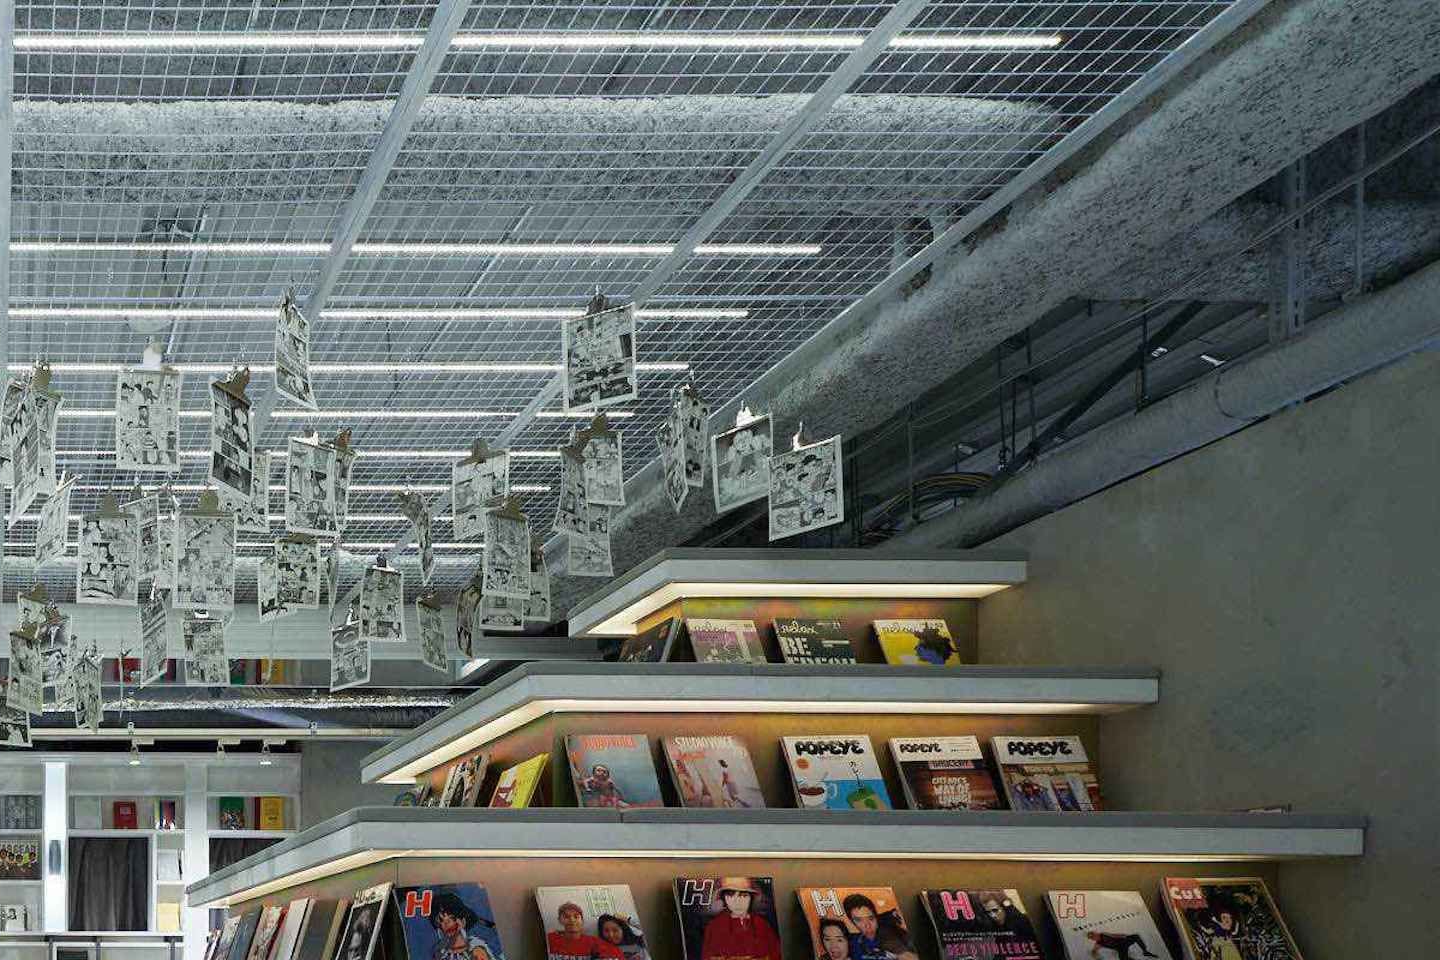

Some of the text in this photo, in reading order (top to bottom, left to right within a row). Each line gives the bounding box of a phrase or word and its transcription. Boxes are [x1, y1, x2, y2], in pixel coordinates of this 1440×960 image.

[795, 741, 864, 755] POPEYE
[899, 743, 942, 753] POPEYE
[1008, 741, 1072, 755] POPEYE
[405, 890, 433, 918] H
[682, 879, 714, 905] H
[940, 891, 975, 920] H
[1058, 893, 1086, 919] H
